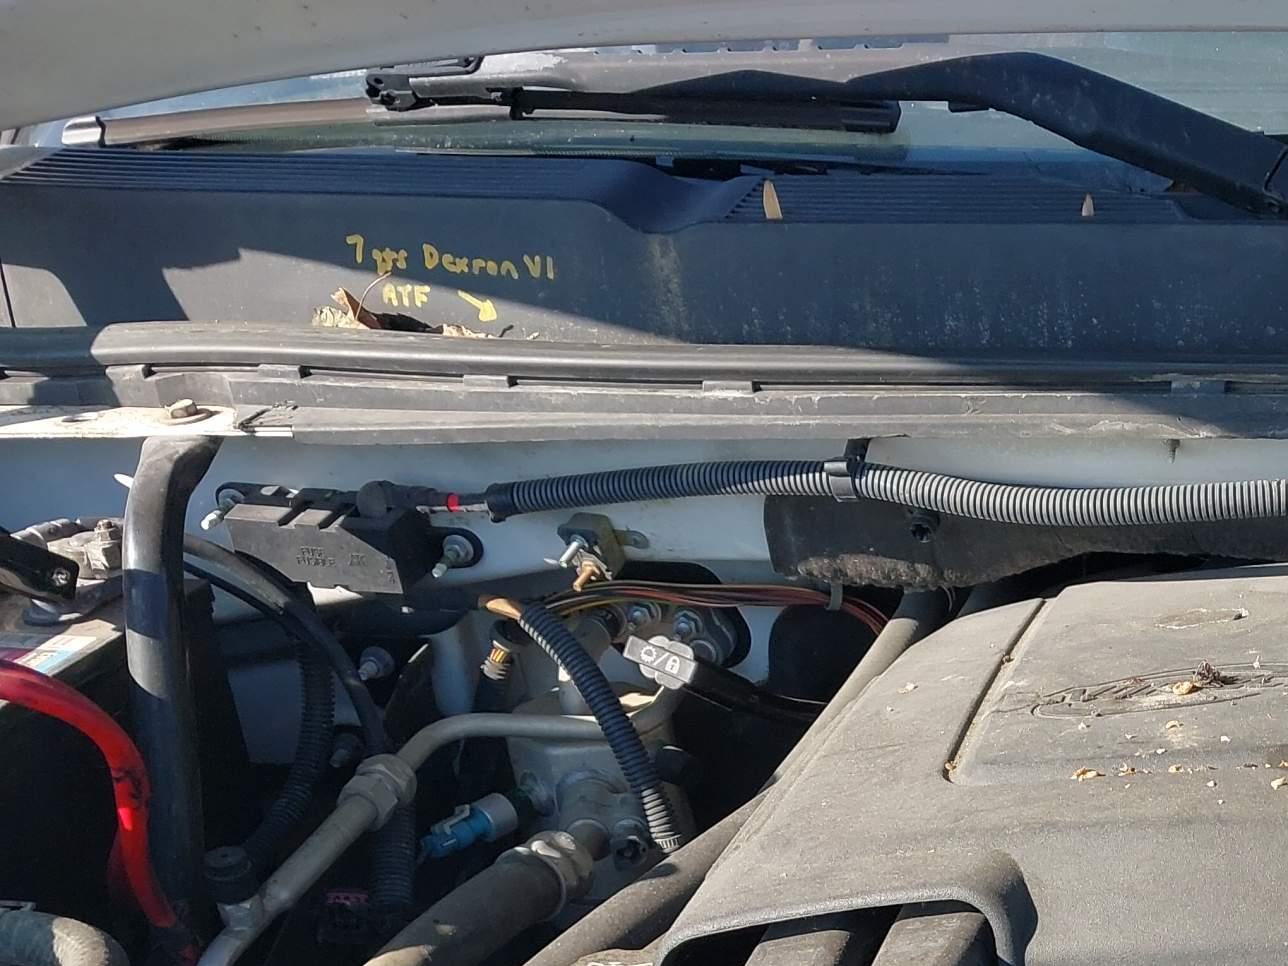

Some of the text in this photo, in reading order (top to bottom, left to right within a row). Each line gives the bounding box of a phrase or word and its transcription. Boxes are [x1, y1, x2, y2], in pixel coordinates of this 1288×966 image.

[346, 234, 364, 264] 7
[422, 243, 519, 280] Dexron
[382, 283, 431, 307] ATF
